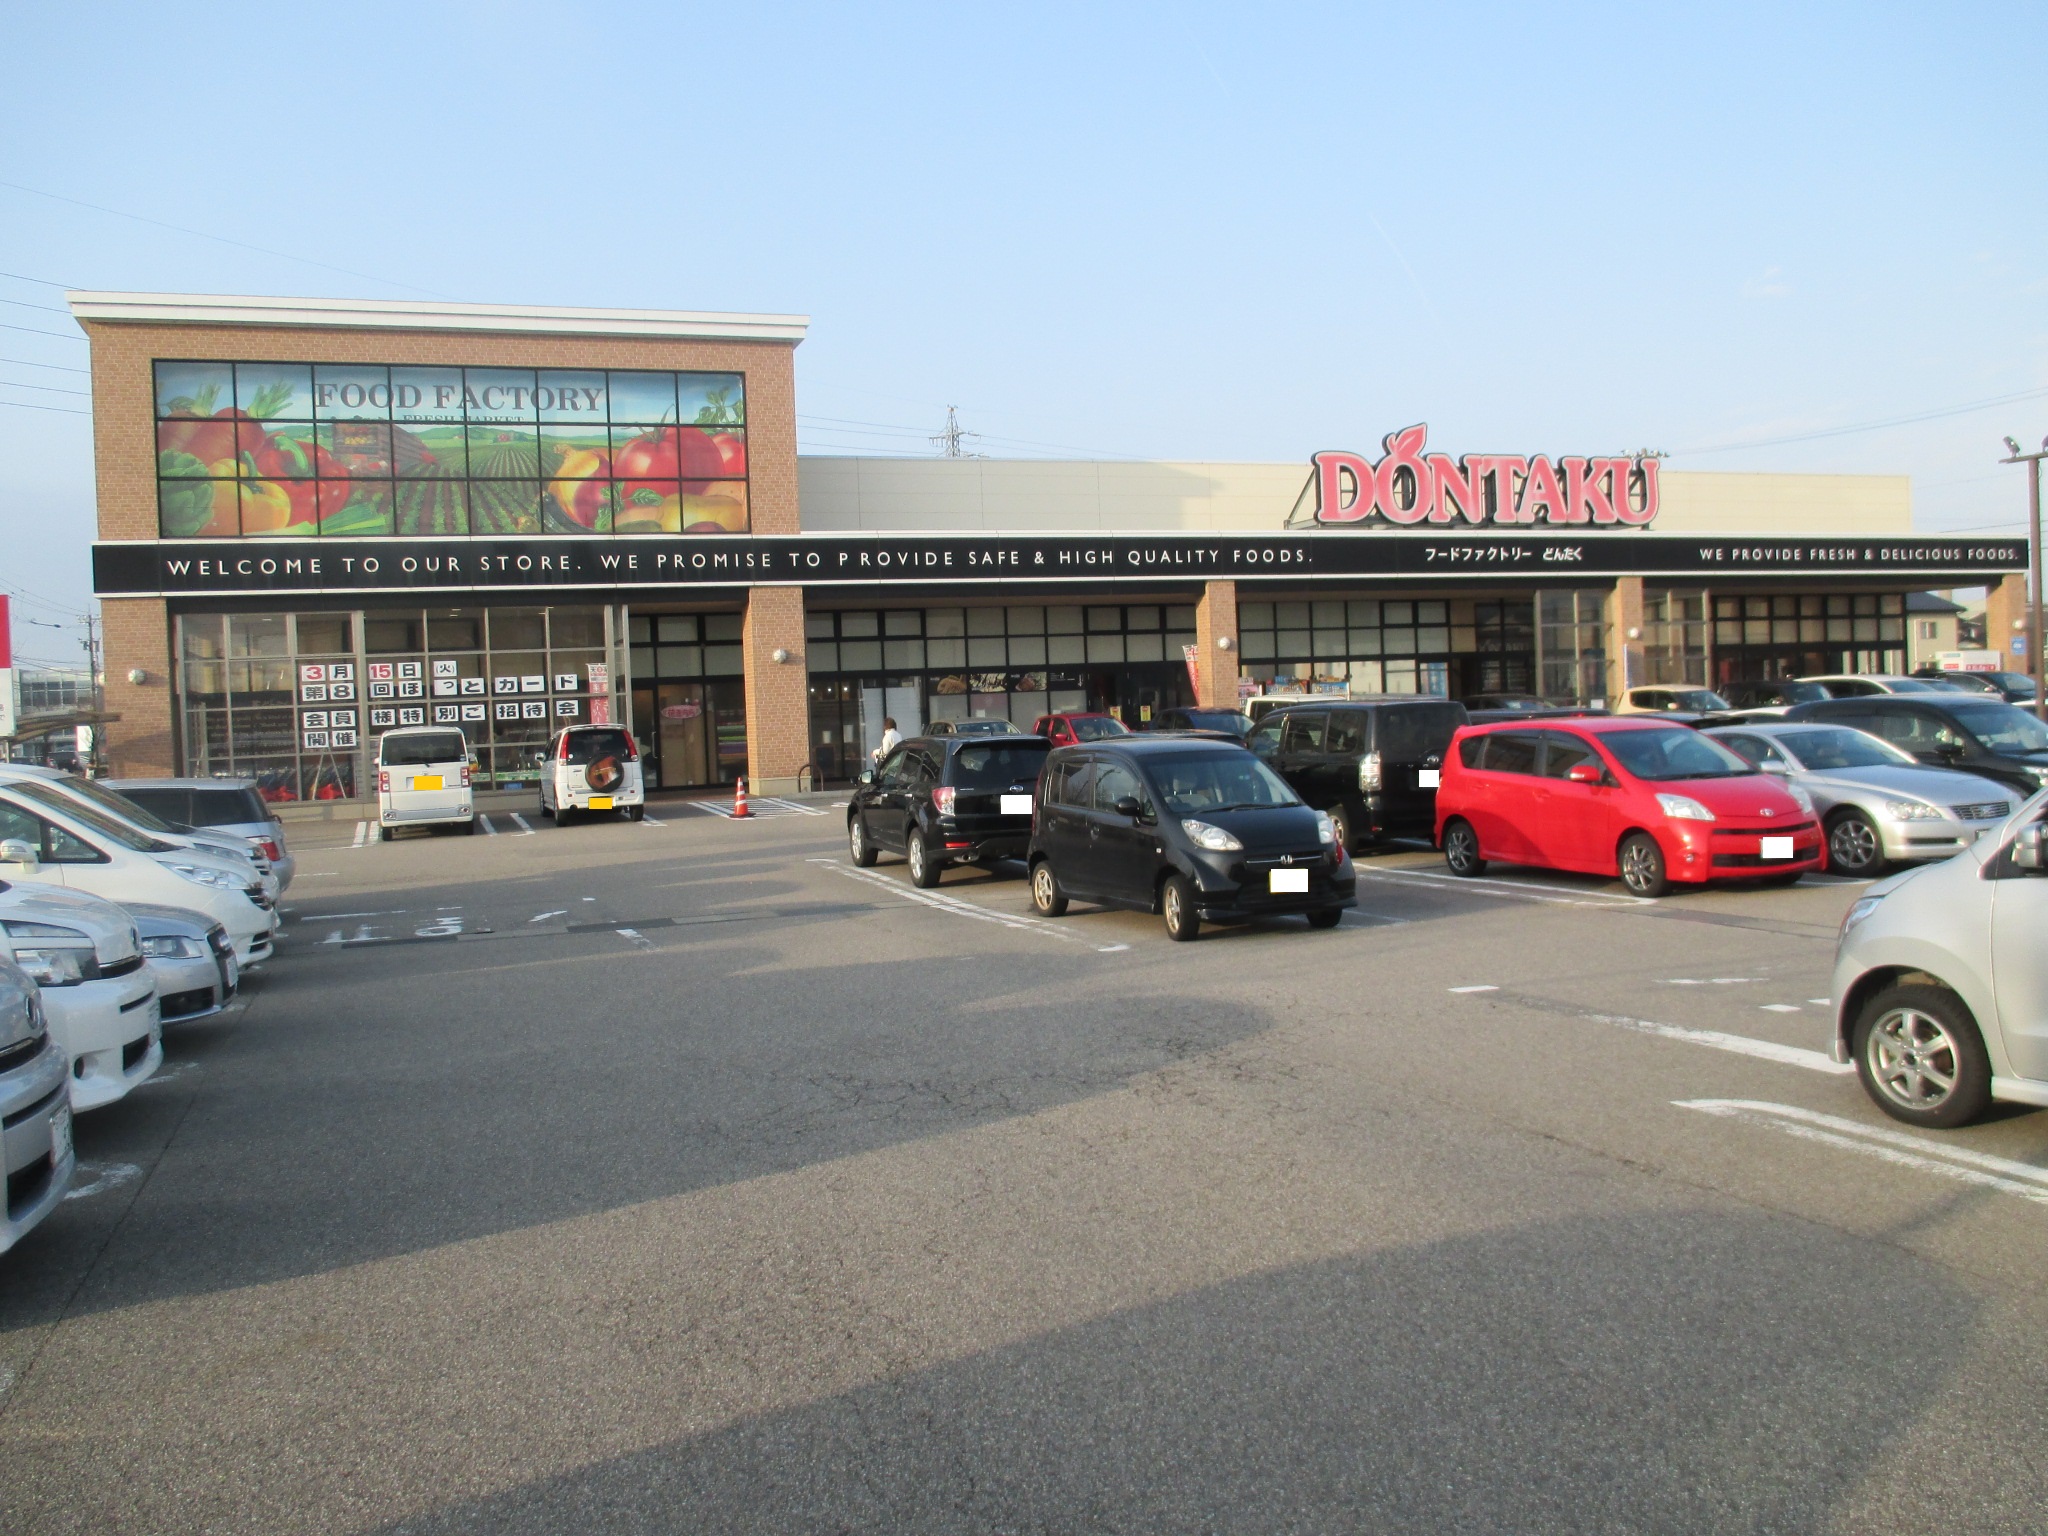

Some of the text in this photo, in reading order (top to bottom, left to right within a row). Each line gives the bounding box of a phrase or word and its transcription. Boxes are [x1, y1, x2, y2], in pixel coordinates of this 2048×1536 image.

[314, 382, 605, 412] FOOD FACTORY
[1311, 422, 1660, 525] DONTAKU
[167, 549, 1314, 577] WELCOME TO OUR STORE. WE PROMISE TO PROVIDE SAFE & HIGH QUALITY FOODS.
[1425, 546, 1583, 562] フードファクトリー どんたく
[1699, 547, 2019, 561] WE PROVIDE FRESH & DELICIOUS FOODS.
[306, 701, 575, 727] 会員様特別ご招待会
[307, 731, 353, 747] 開催
